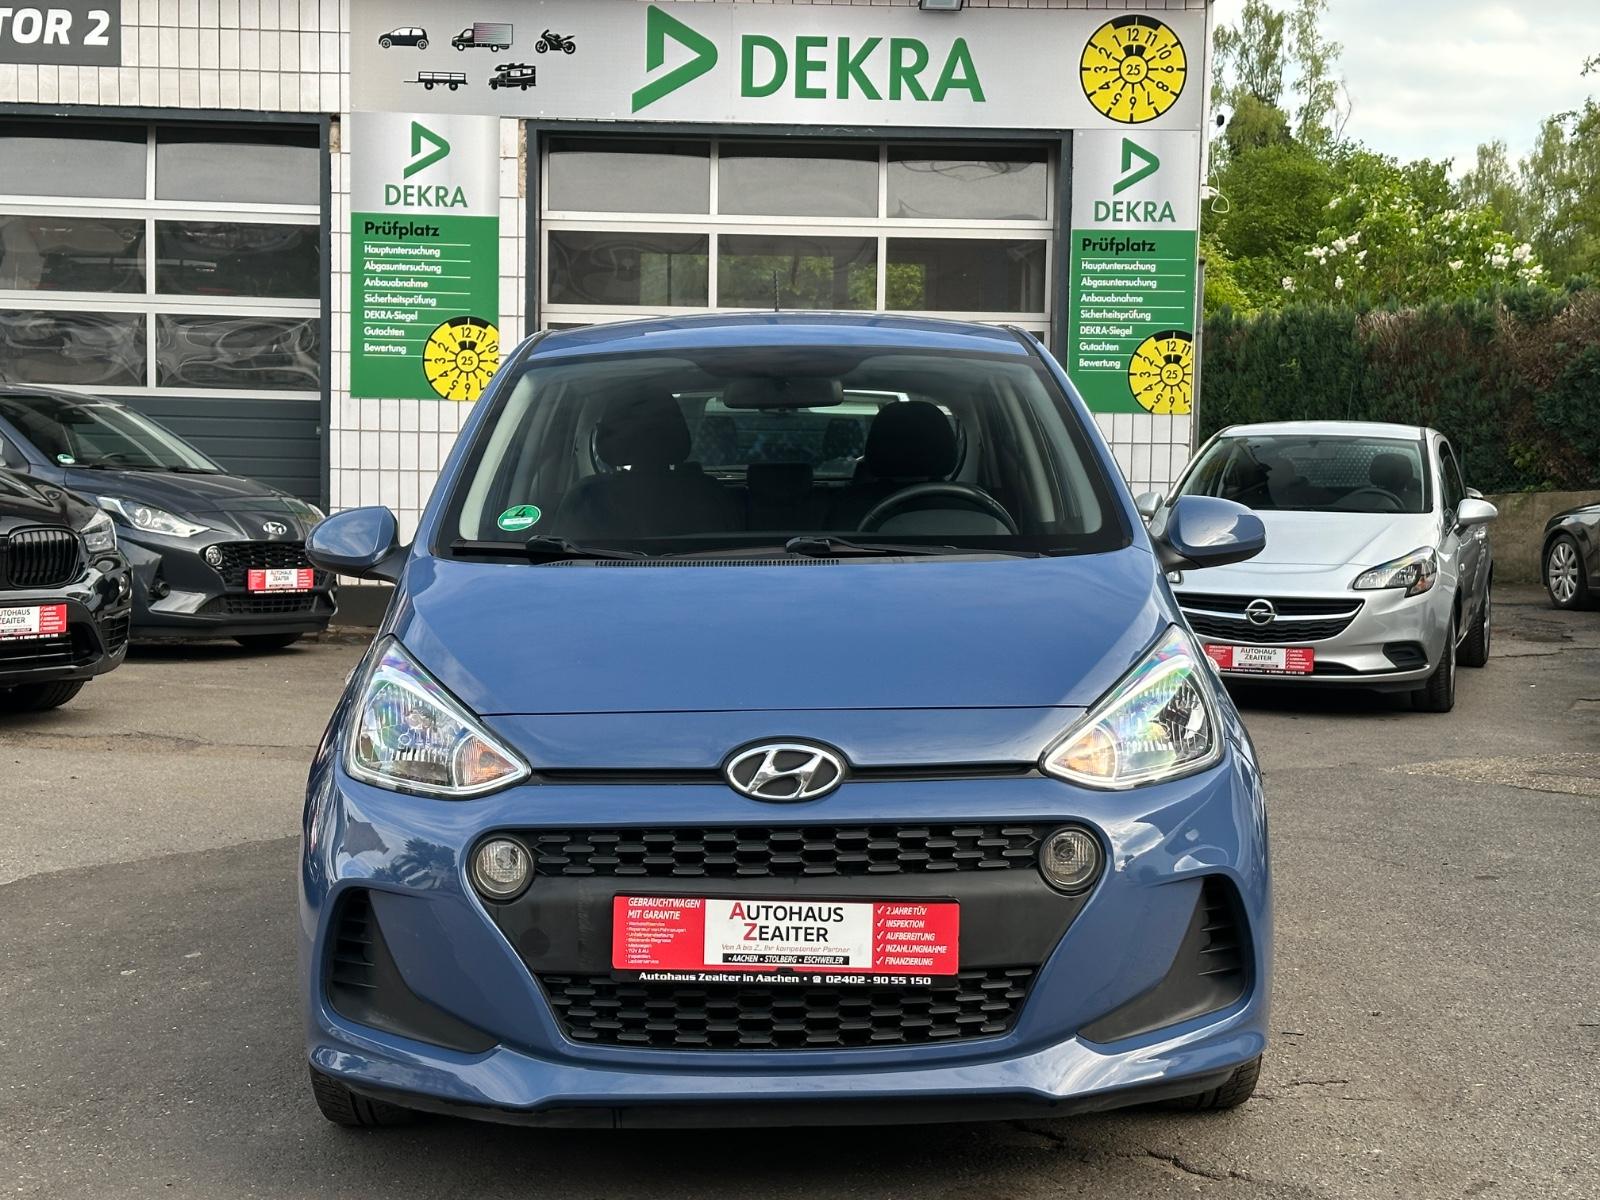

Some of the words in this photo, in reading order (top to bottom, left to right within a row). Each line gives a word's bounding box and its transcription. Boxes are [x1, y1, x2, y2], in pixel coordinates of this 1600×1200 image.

[83, 9, 110, 46] 2
[1112, 34, 1121, 48] 1
[1126, 28, 1139, 42] 12
[1145, 31, 1158, 47] 11
[1098, 46, 1112, 59] 2
[1156, 43, 1172, 60] 10
[741, 34, 986, 102] DEKRA
[1094, 66, 1108, 74] 3
[1126, 64, 1140, 76] 25
[1098, 81, 1111, 90] 4
[1156, 81, 1169, 92] 8
[1111, 92, 1122, 106] 5
[384, 184, 468, 208] DEKRA
[1094, 200, 1176, 223] DEKRA
[364, 221, 440, 240] Prüfplatz
[364, 245, 441, 258] Hauptuntersuchung
[1082, 237, 1156, 255] Prüfplatz
[364, 261, 442, 274] Abgasuntersuchung
[1082, 261, 1156, 272] Hauptuntersuchung
[364, 278, 429, 288] Anbauabnahme
[1081, 277, 1157, 288] Abgasuntersuchung
[364, 294, 437, 307] Sicherheitsprüfung
[1081, 293, 1143, 303] Anbauabnahme
[364, 311, 418, 322] DEKRA-Siegel
[1080, 309, 1151, 321] Sicherheitsprüfung
[364, 327, 405, 337] Gutachten
[461, 327, 472, 339] 12
[476, 330, 487, 343] 11
[1080, 325, 1133, 336] DEKRA-Siegel
[449, 332, 457, 343] 1
[364, 343, 407, 355] Bewertung
[438, 342, 449, 352] 2
[486, 340, 499, 353] 10
[1079, 342, 1119, 351] Gutachten
[1154, 346, 1162, 357] 1
[1166, 340, 1177, 352] 12
[1181, 343, 1191, 356] 11
[461, 356, 473, 366] 25
[1079, 359, 1121, 370] Bewertung
[1143, 356, 1154, 366] 2
[1165, 370, 1178, 379] 25
[515, 507, 526, 517] 4
[628, 897, 701, 909] GEBRAUCHTWAGEN
[627, 909, 642, 919] MIT
[643, 910, 681, 920] GARANTIE
[729, 902, 844, 923] AUTOHAUS
[886, 906, 891, 915] 2
[891, 907, 913, 915] JAHRE
[913, 905, 927, 916] TÜV
[885, 919, 925, 928] INSPEKTION
[743, 922, 829, 942] ZEAITER
[885, 931, 936, 941] AUFBEREITUNG
[885, 944, 948, 953] INZAHLUNGNAHME
[732, 954, 758, 962] AACHEN
[764, 955, 797, 963] STOLBERG
[804, 956, 844, 965] ESCHWEILER
[885, 956, 934, 966] FINANZIERUNG
[638, 971, 696, 981] Autohaus
[698, 972, 741, 982] Zeaiter
[743, 973, 754, 982] in
[755, 973, 799, 983] Aachen
[891, 976, 906, 984] 55
[910, 977, 931, 985] 150
